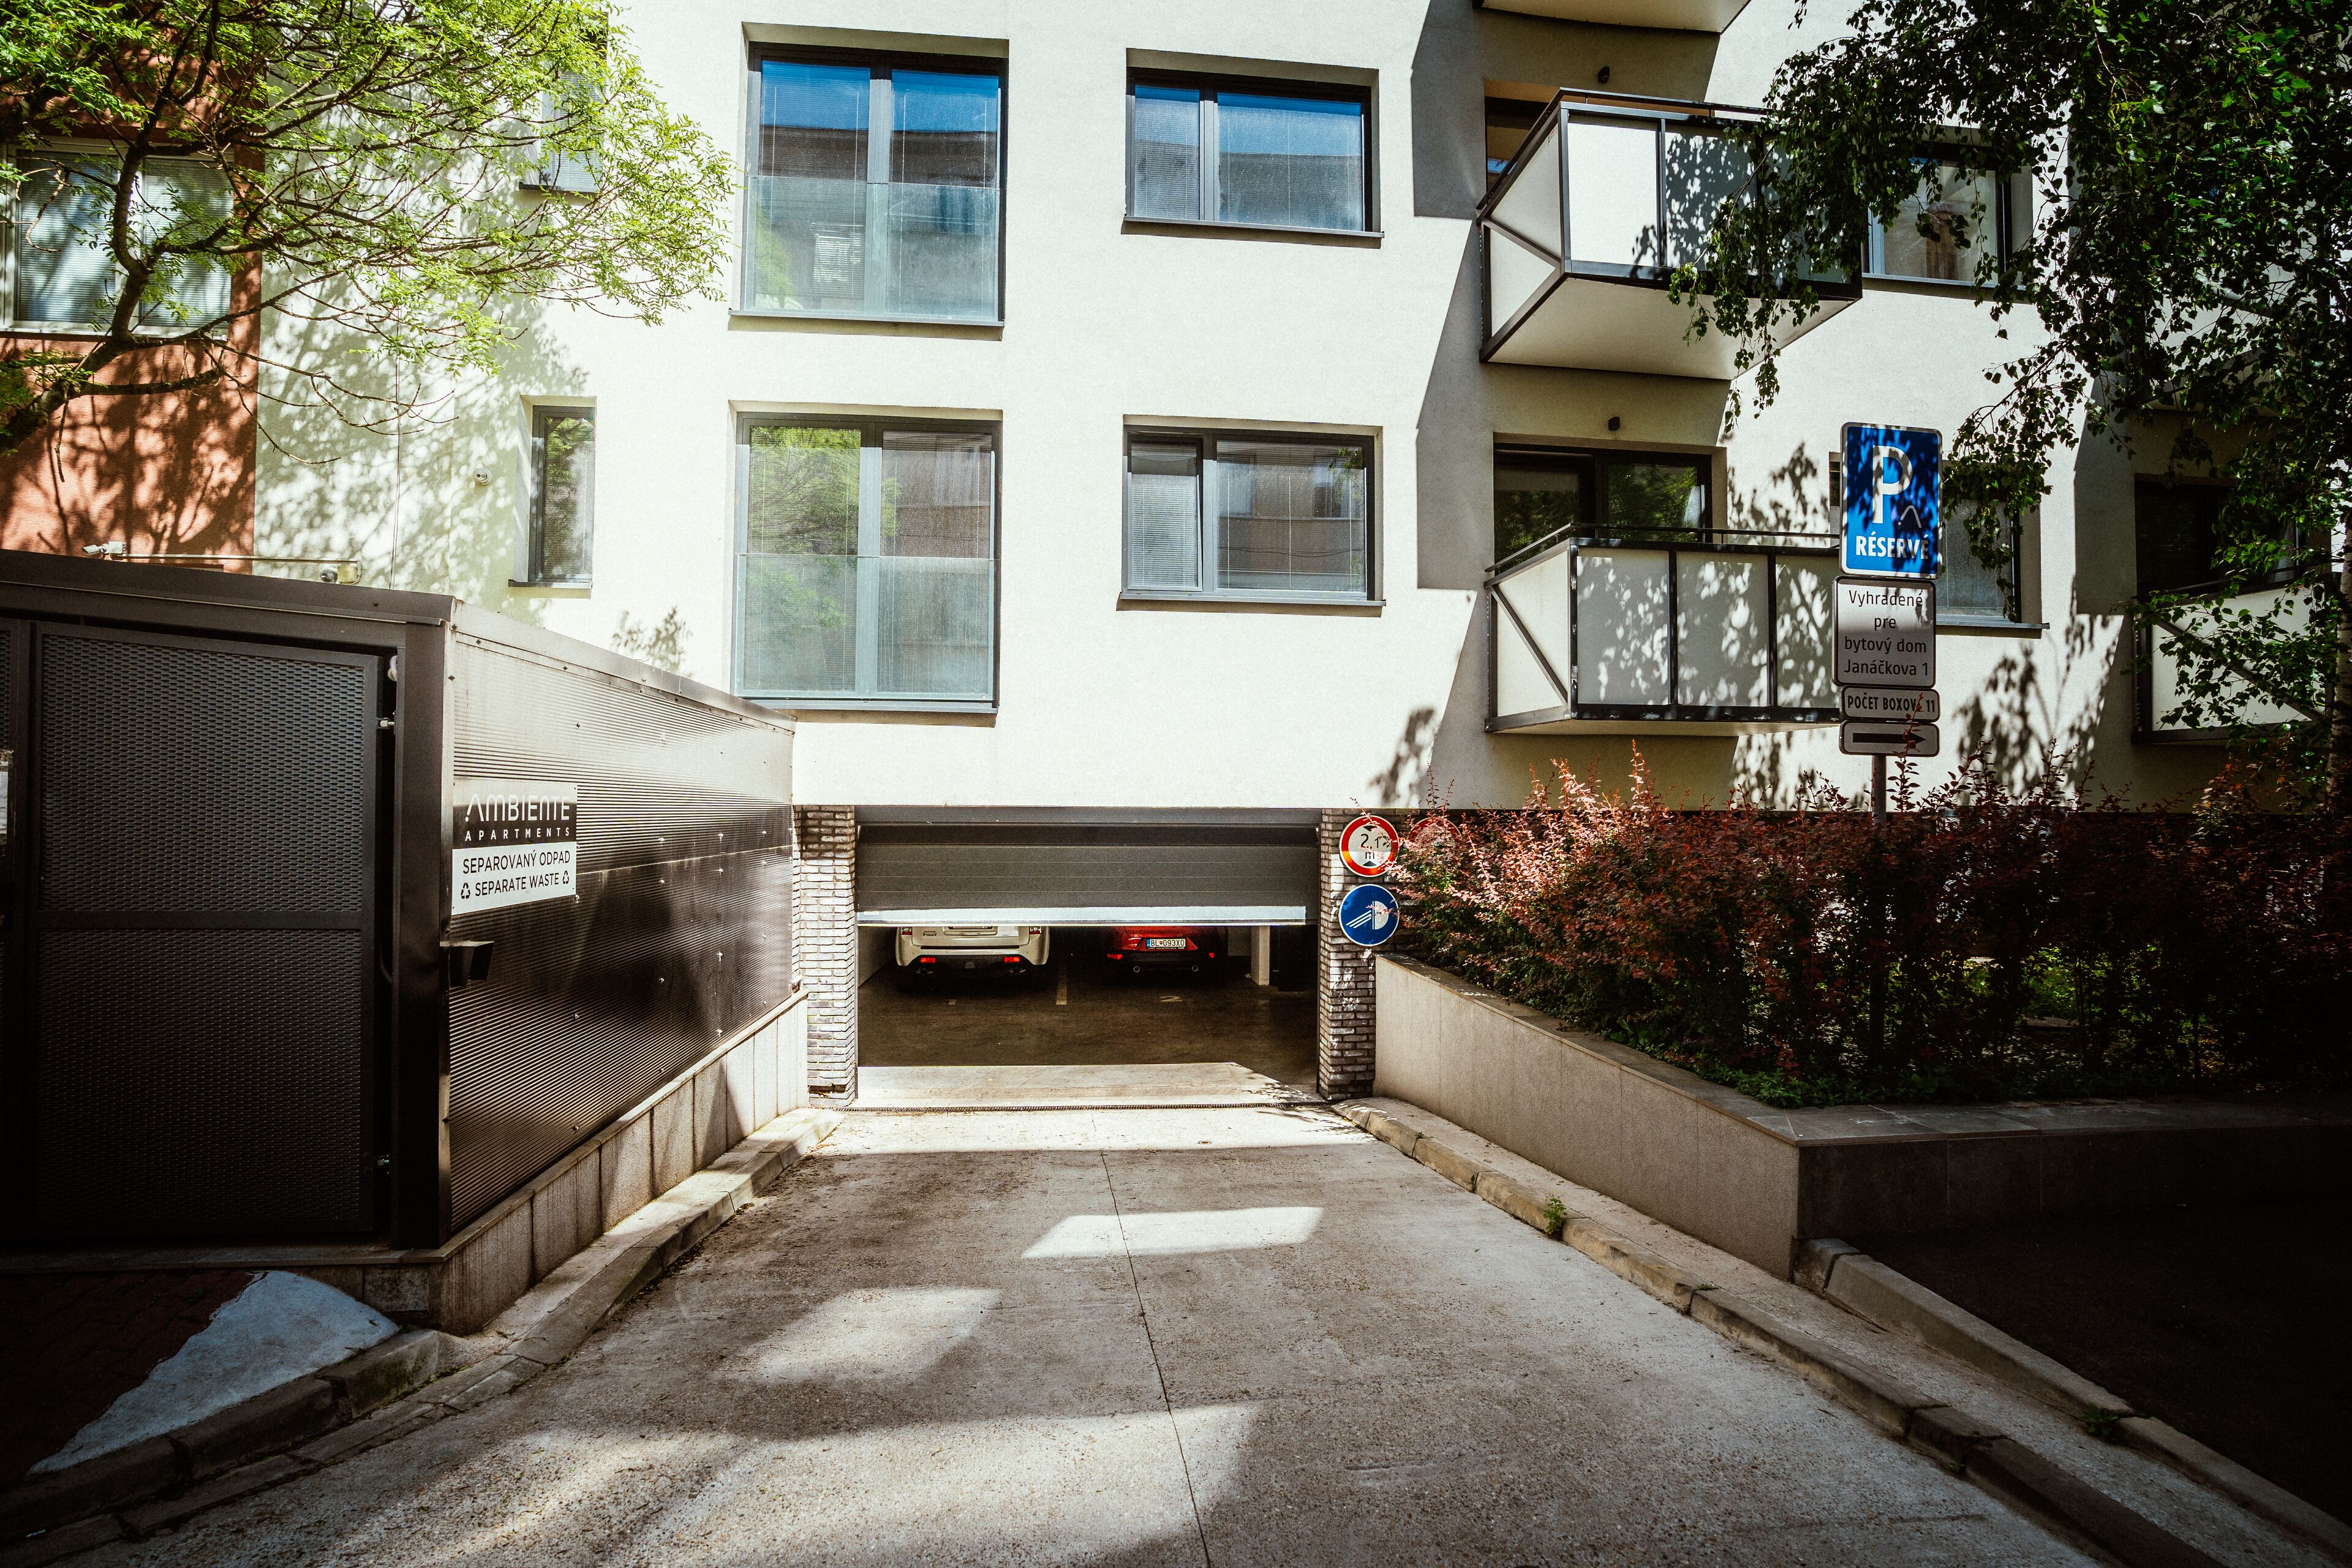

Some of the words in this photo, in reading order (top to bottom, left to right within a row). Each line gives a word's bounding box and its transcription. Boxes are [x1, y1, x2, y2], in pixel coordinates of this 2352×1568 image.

[1872, 445, 1913, 524] P
[1855, 530, 1929, 560] RÉSERVÉ
[1849, 590, 1923, 608] Vyhradené
[1874, 617, 1896, 631] pre
[1845, 636, 1891, 654] bytový
[1897, 639, 1926, 653] dom
[1844, 659, 1917, 676] Janáčkova
[1922, 662, 1928, 676] 1
[1847, 692, 1879, 710] POČET
[1926, 699, 1936, 712] 11
[465, 793, 570, 822] AMBIENTE
[465, 827, 570, 842] APARTMENTS
[463, 850, 537, 874] SEPAROVANÝ
[540, 851, 570, 865] ODPAD
[475, 876, 527, 897] SEPARATE
[529, 873, 559, 888] WASTE
